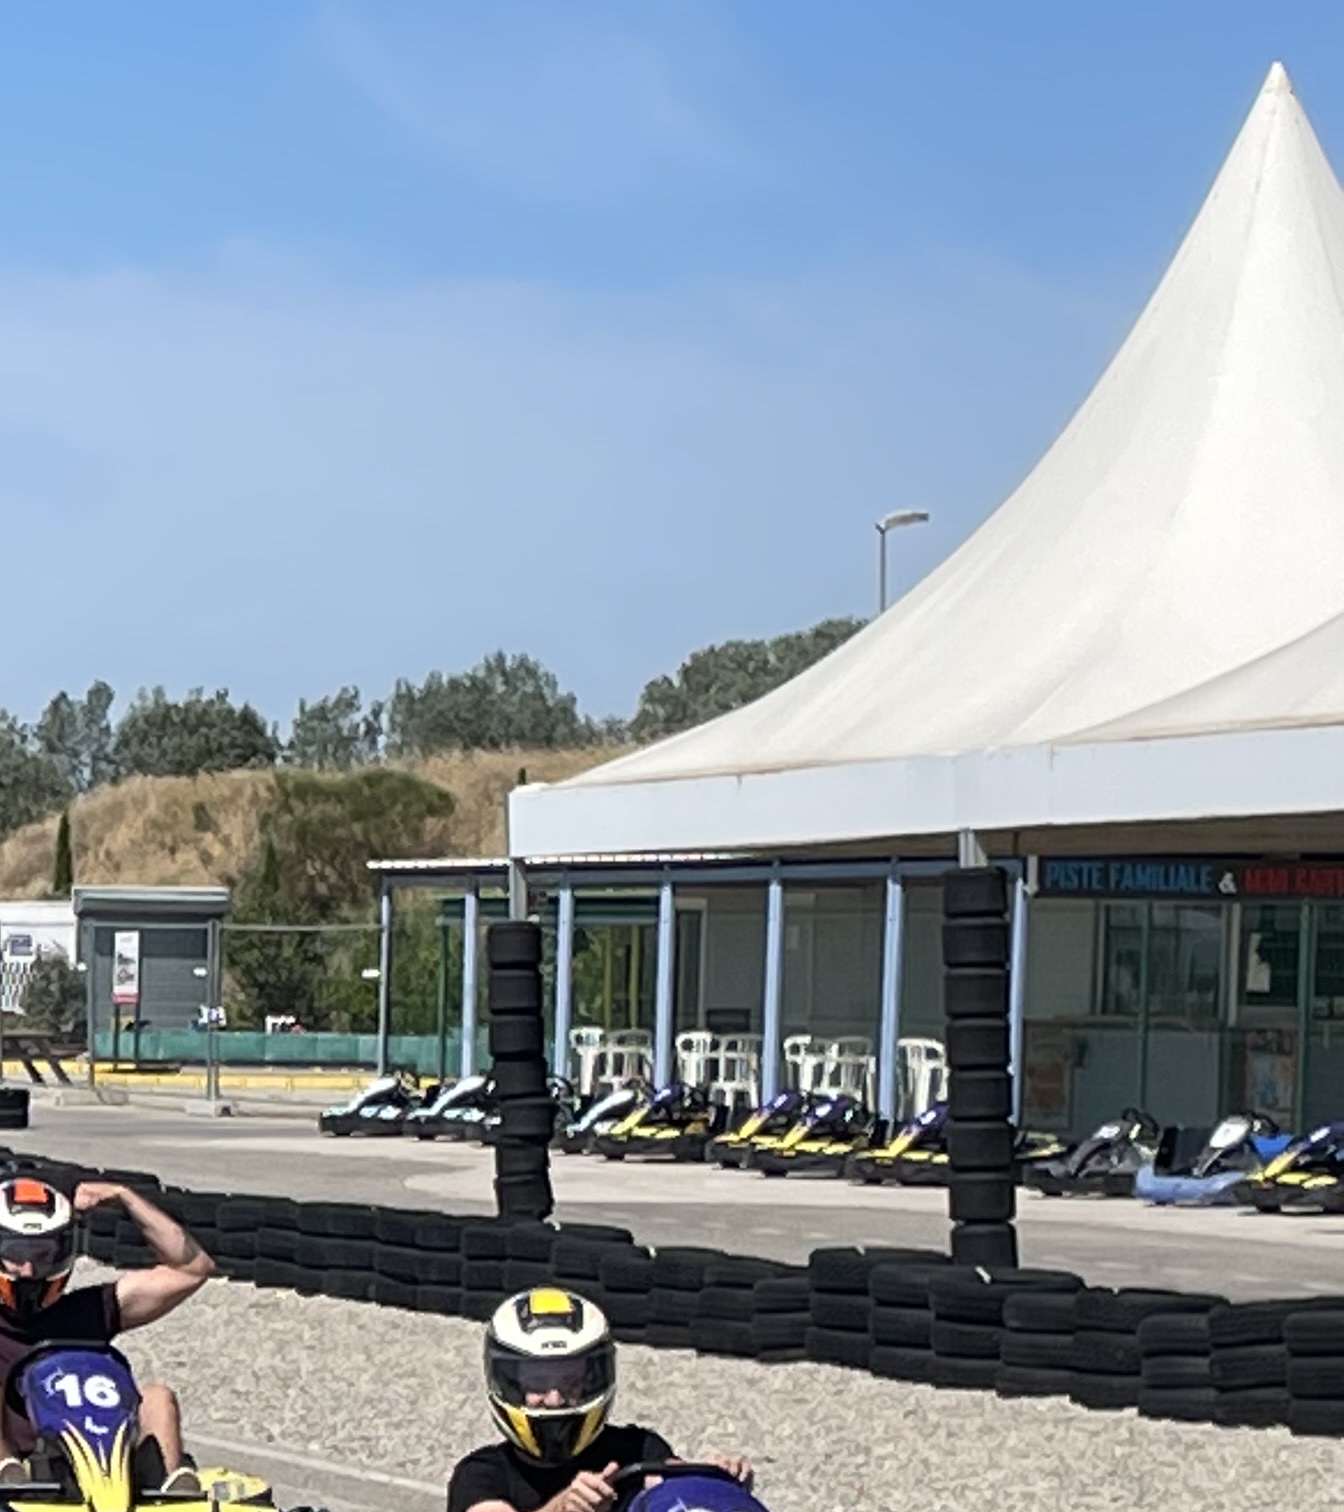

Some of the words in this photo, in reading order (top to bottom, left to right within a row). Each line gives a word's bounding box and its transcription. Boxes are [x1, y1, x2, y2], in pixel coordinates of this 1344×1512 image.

[1045, 860, 1104, 890] PISTE
[1109, 861, 1213, 893] FAMILIALE
[1218, 870, 1238, 895] &
[54, 1374, 120, 1408] 16
